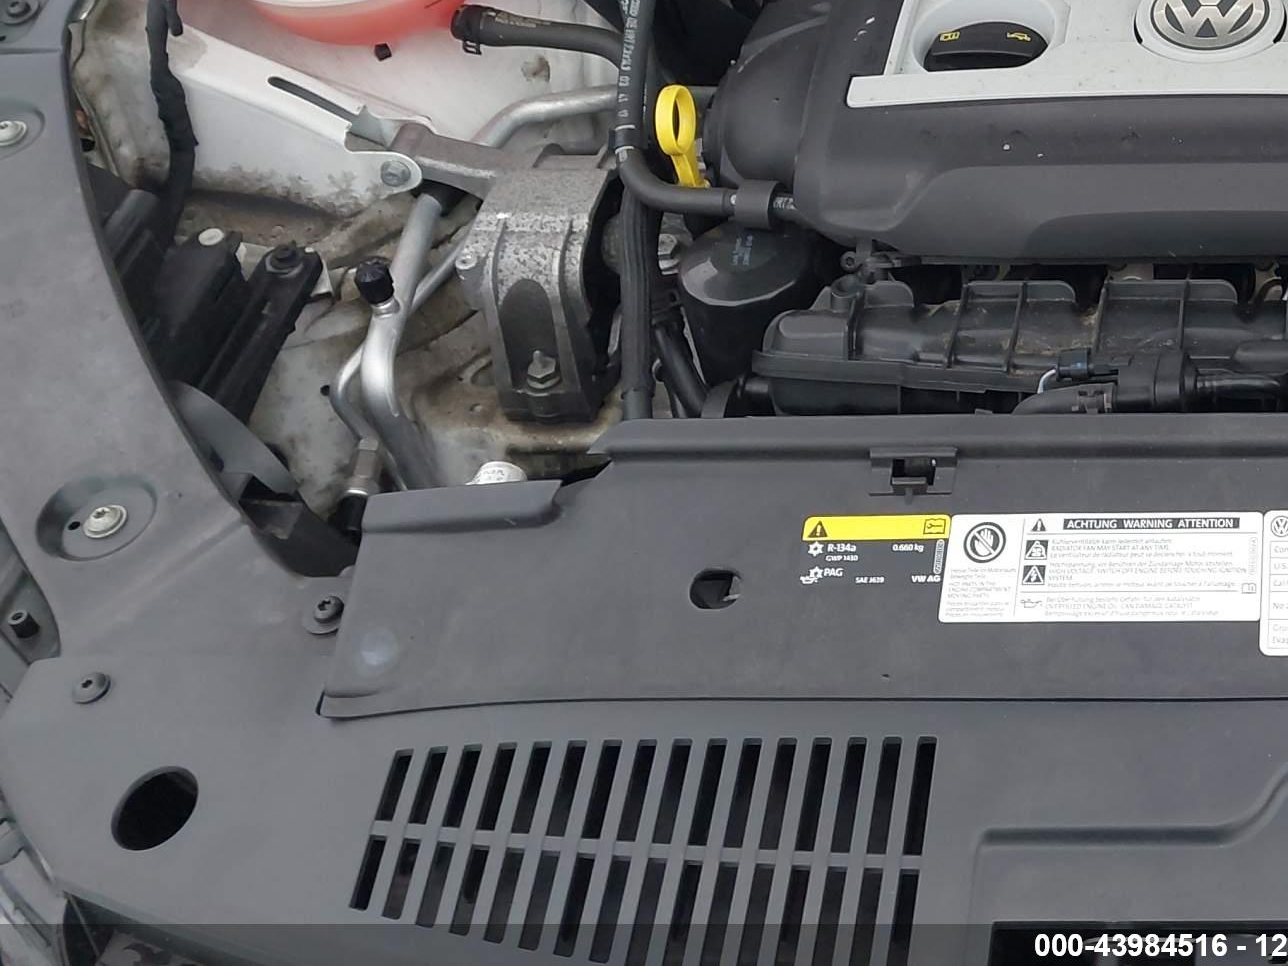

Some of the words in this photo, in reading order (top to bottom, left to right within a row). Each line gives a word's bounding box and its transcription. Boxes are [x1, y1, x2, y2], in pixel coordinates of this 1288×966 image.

[1067, 519, 1118, 529] ACHTUNG
[1124, 518, 1173, 528] WARNING
[1178, 518, 1234, 528] ATTENTION
[827, 543, 858, 553] R-134a
[914, 544, 924, 553] kg
[824, 568, 844, 577] PAG
[855, 576, 869, 584] SAE
[911, 575, 926, 583] VW
[927, 575, 942, 583] AG
[1272, 602, 1284, 610] No
